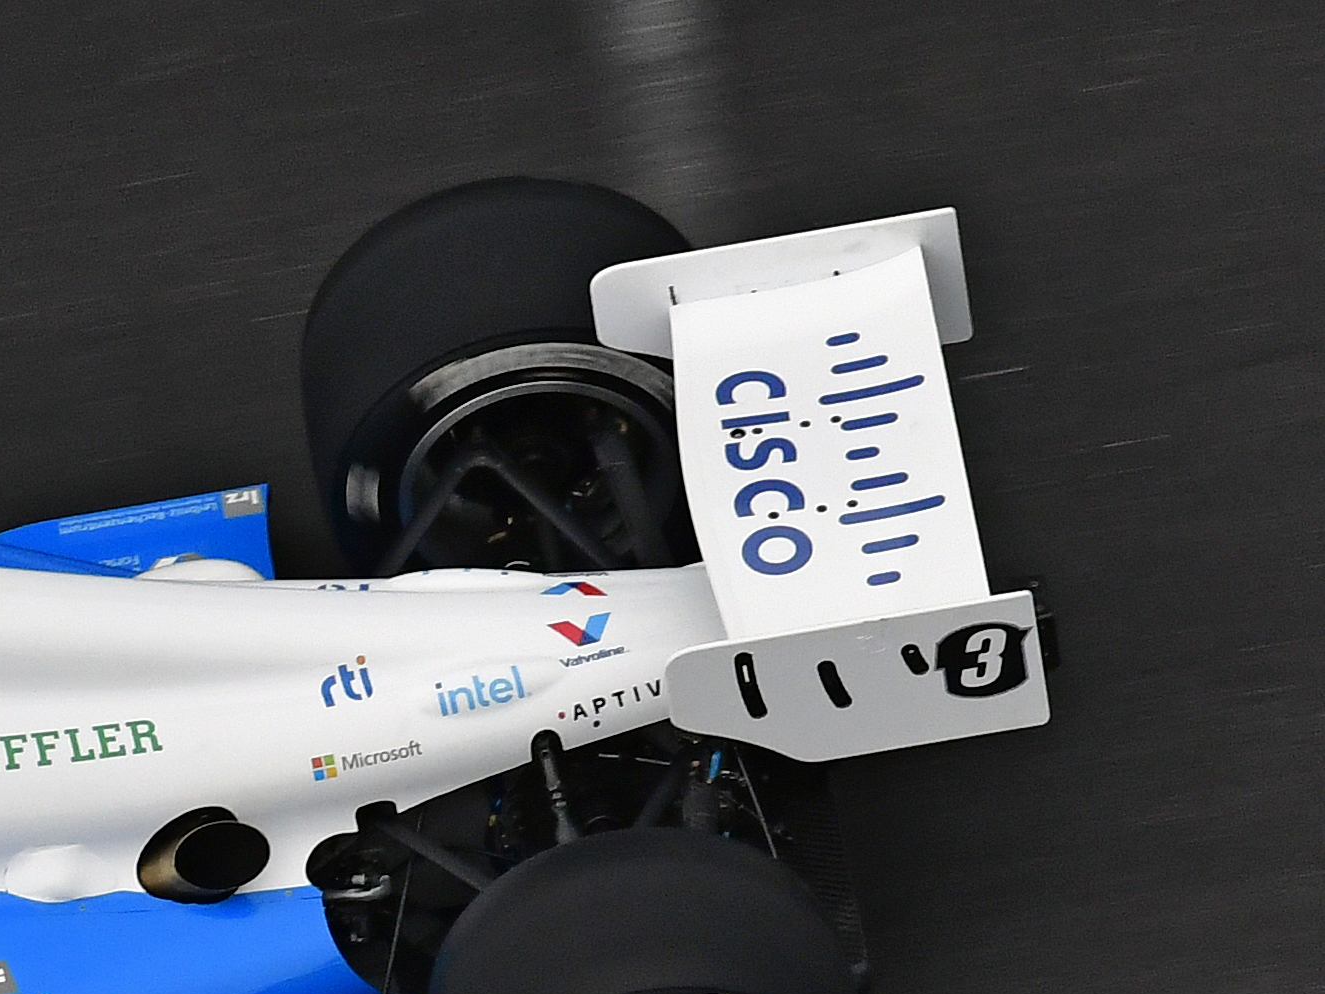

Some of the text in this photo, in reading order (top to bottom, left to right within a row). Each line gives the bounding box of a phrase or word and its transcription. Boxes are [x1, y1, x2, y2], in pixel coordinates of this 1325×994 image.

[715, 370, 813, 576] CISCO
[559, 645, 626, 668] Valvoline
[960, 628, 1007, 688] 3
[320, 655, 374, 707] rti
[572, 680, 662, 721] APTIV
[341, 740, 423, 771] Microsoft
